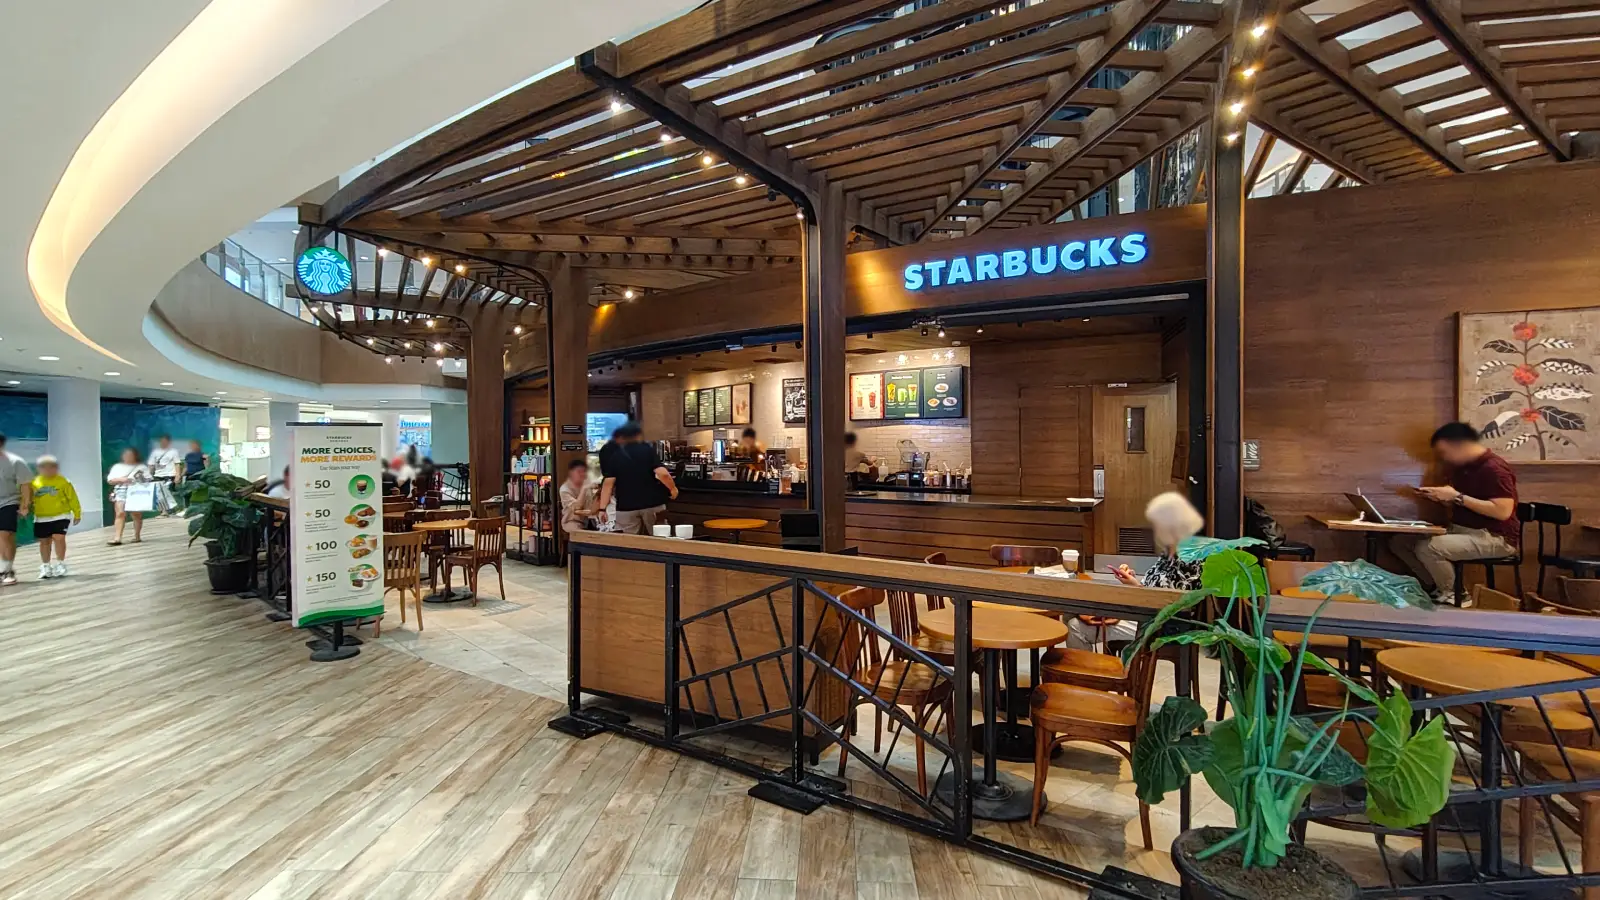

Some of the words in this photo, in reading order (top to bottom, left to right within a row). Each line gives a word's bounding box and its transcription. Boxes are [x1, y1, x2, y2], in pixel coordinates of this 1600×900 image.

[904, 233, 1147, 290] STARBUCKS
[314, 480, 331, 489] 50
[315, 509, 331, 518] 50
[316, 541, 337, 551] 100
[316, 572, 337, 582] 150
